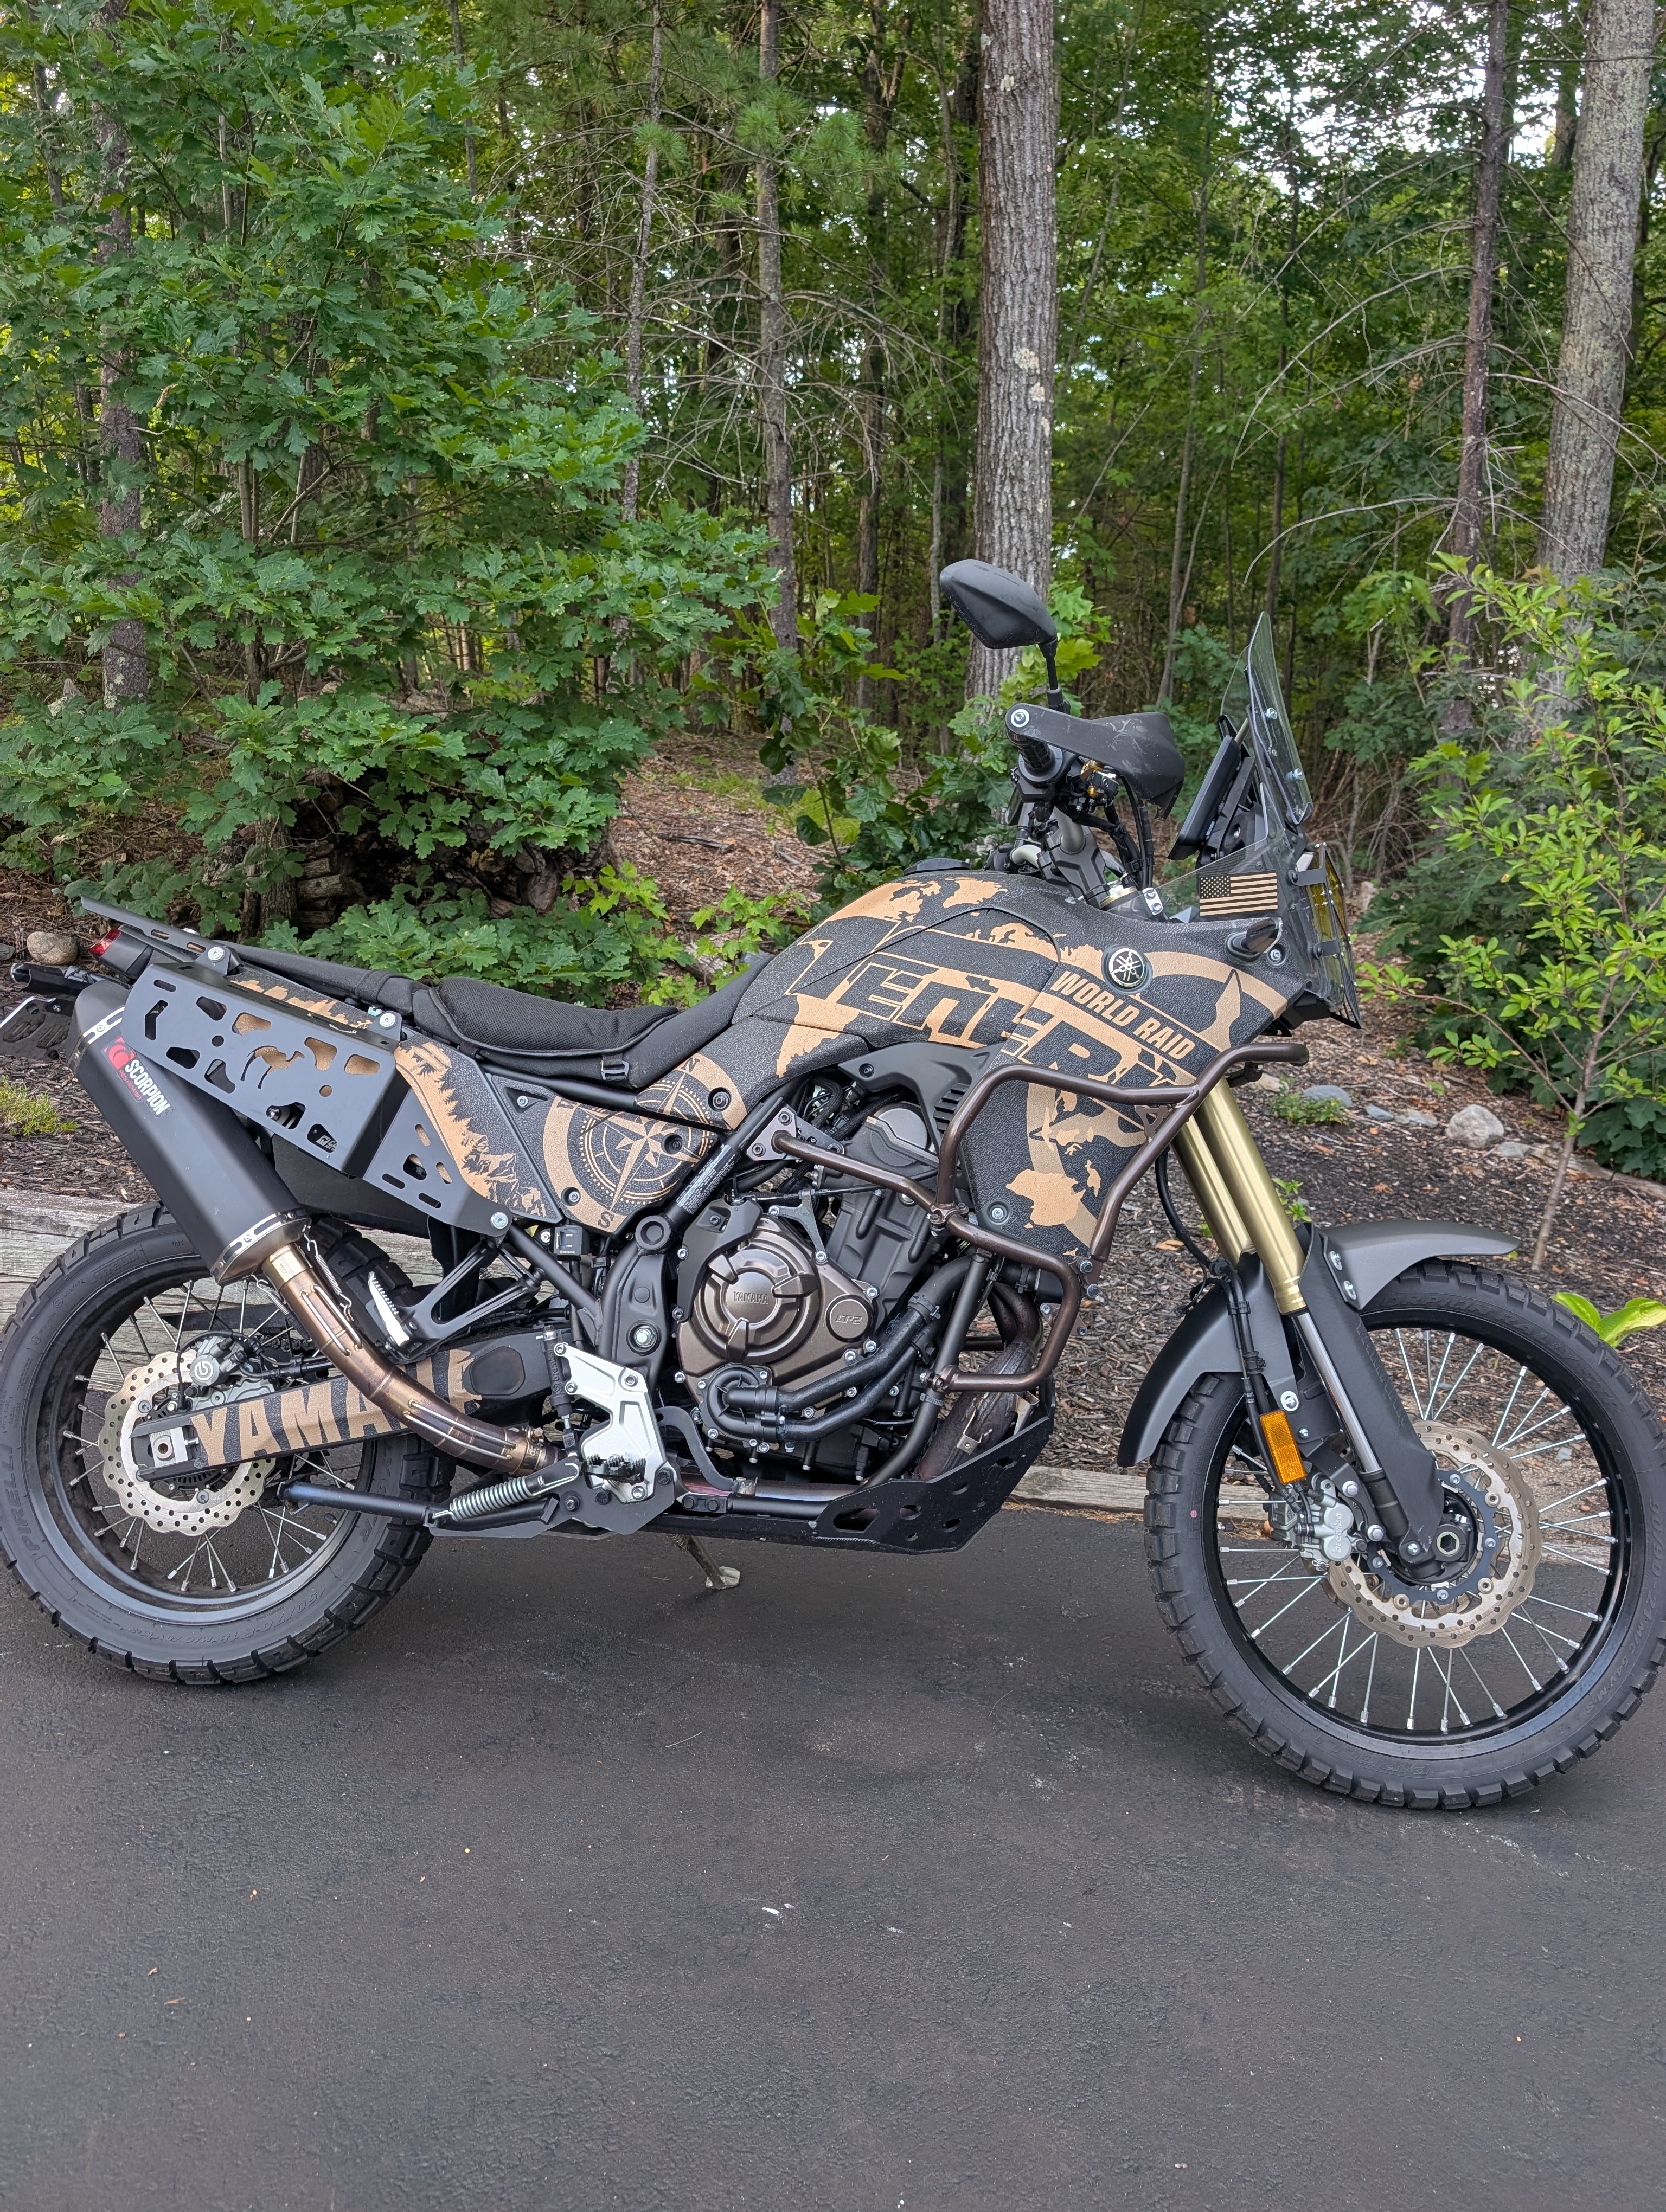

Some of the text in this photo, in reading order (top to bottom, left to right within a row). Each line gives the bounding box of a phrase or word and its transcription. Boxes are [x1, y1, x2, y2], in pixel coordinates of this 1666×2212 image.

[1051, 970, 1196, 1060] WORLD RAID
[681, 1058, 700, 1072] N
[125, 1059, 170, 1115] SCORPION
[598, 1211, 613, 1229] S
[733, 1291, 769, 1305] YAMAHA
[835, 1315, 862, 1326] CP2
[1380, 1294, 1492, 1316] ORPION
[1495, 1311, 1580, 1364] RALLY
[191, 1349, 482, 1467] YAMAA
[0, 1443, 40, 1551] PIRELLI
[1333, 1513, 1342, 1553] brembo
[1315, 1735, 1431, 1775] PIRELLI
